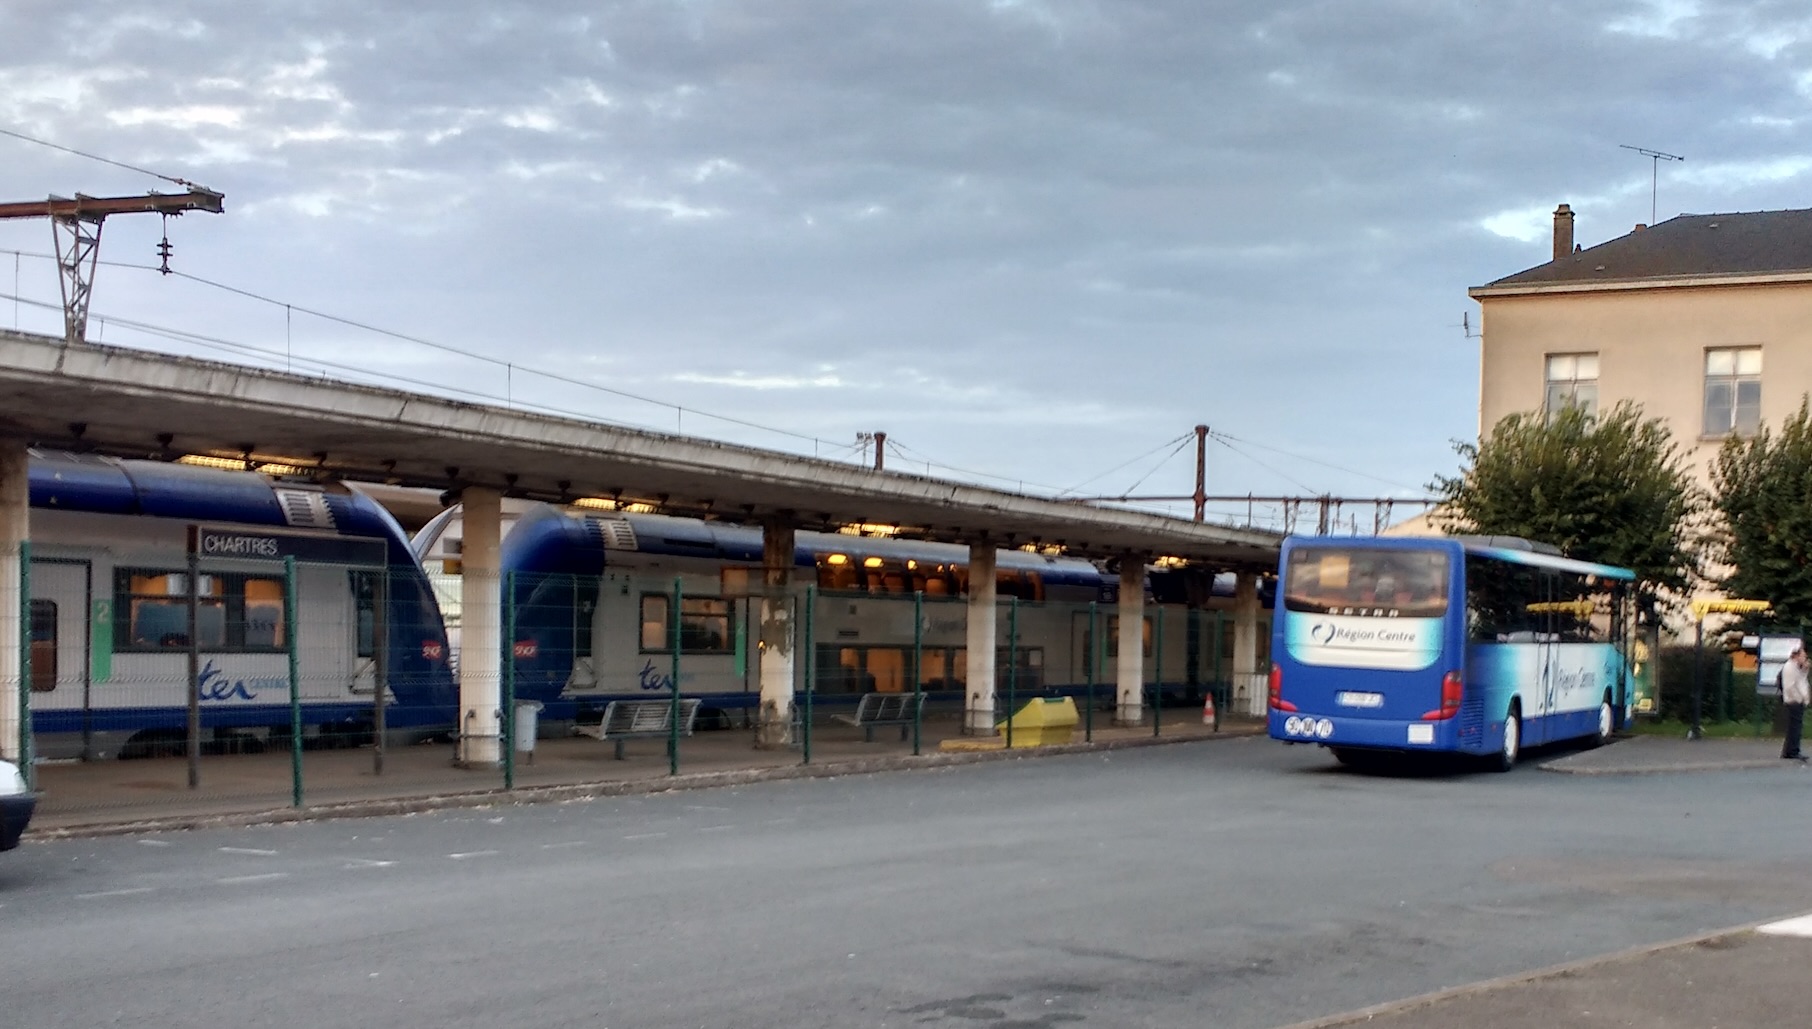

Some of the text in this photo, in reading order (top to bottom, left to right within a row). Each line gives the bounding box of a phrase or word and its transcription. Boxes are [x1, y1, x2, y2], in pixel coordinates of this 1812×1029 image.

[204, 534, 278, 556] CHARTRES
[1336, 627, 1416, 642] Région Centre
